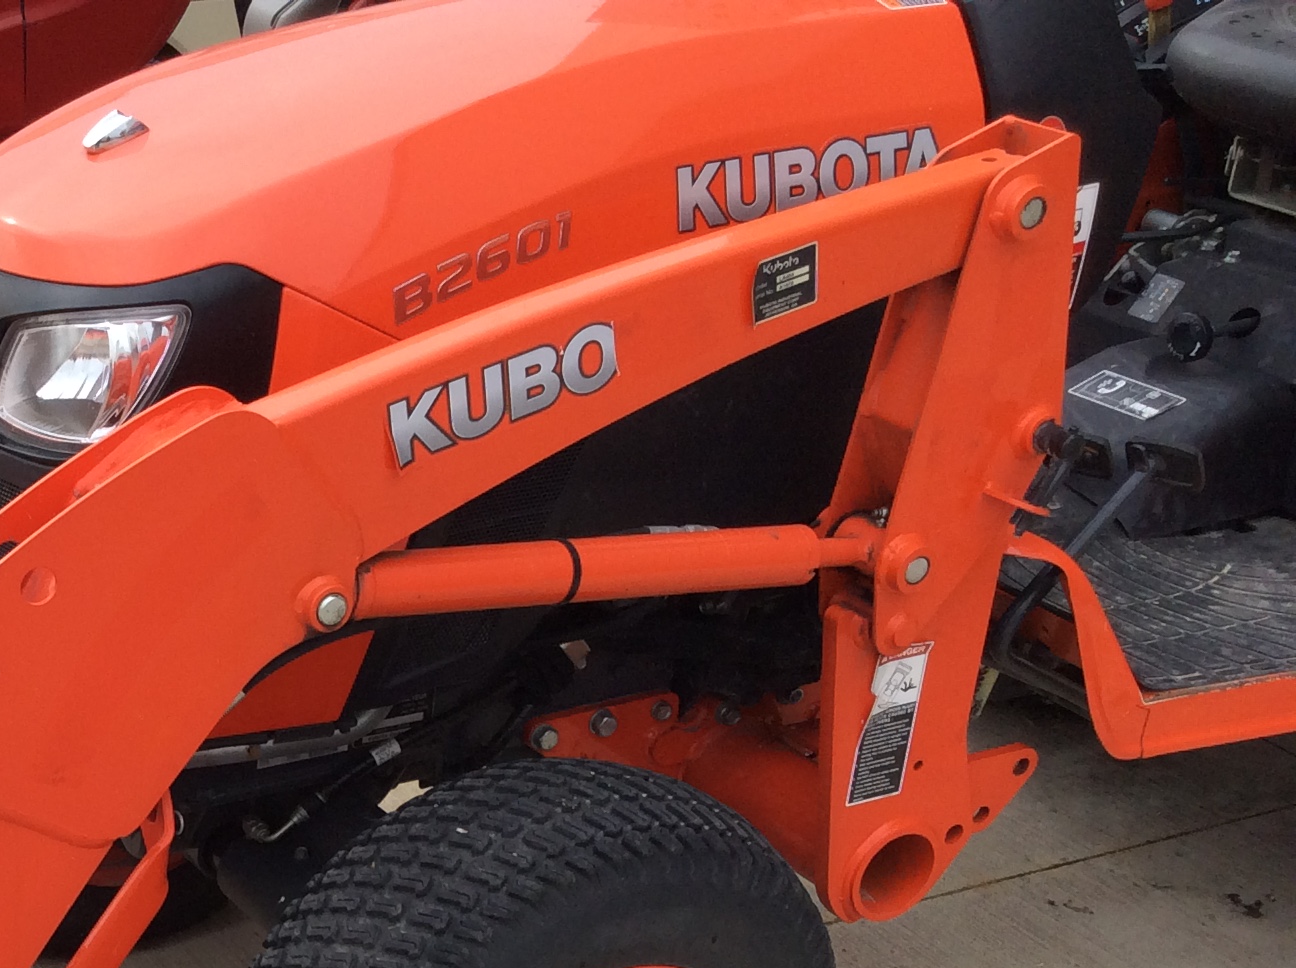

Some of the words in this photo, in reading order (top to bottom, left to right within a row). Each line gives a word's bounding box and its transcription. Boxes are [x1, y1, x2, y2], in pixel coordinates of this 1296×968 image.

[676, 126, 940, 233] KUBOTA
[392, 210, 573, 327] B2601
[762, 255, 800, 275] Kubota
[387, 321, 619, 471] KUBO
